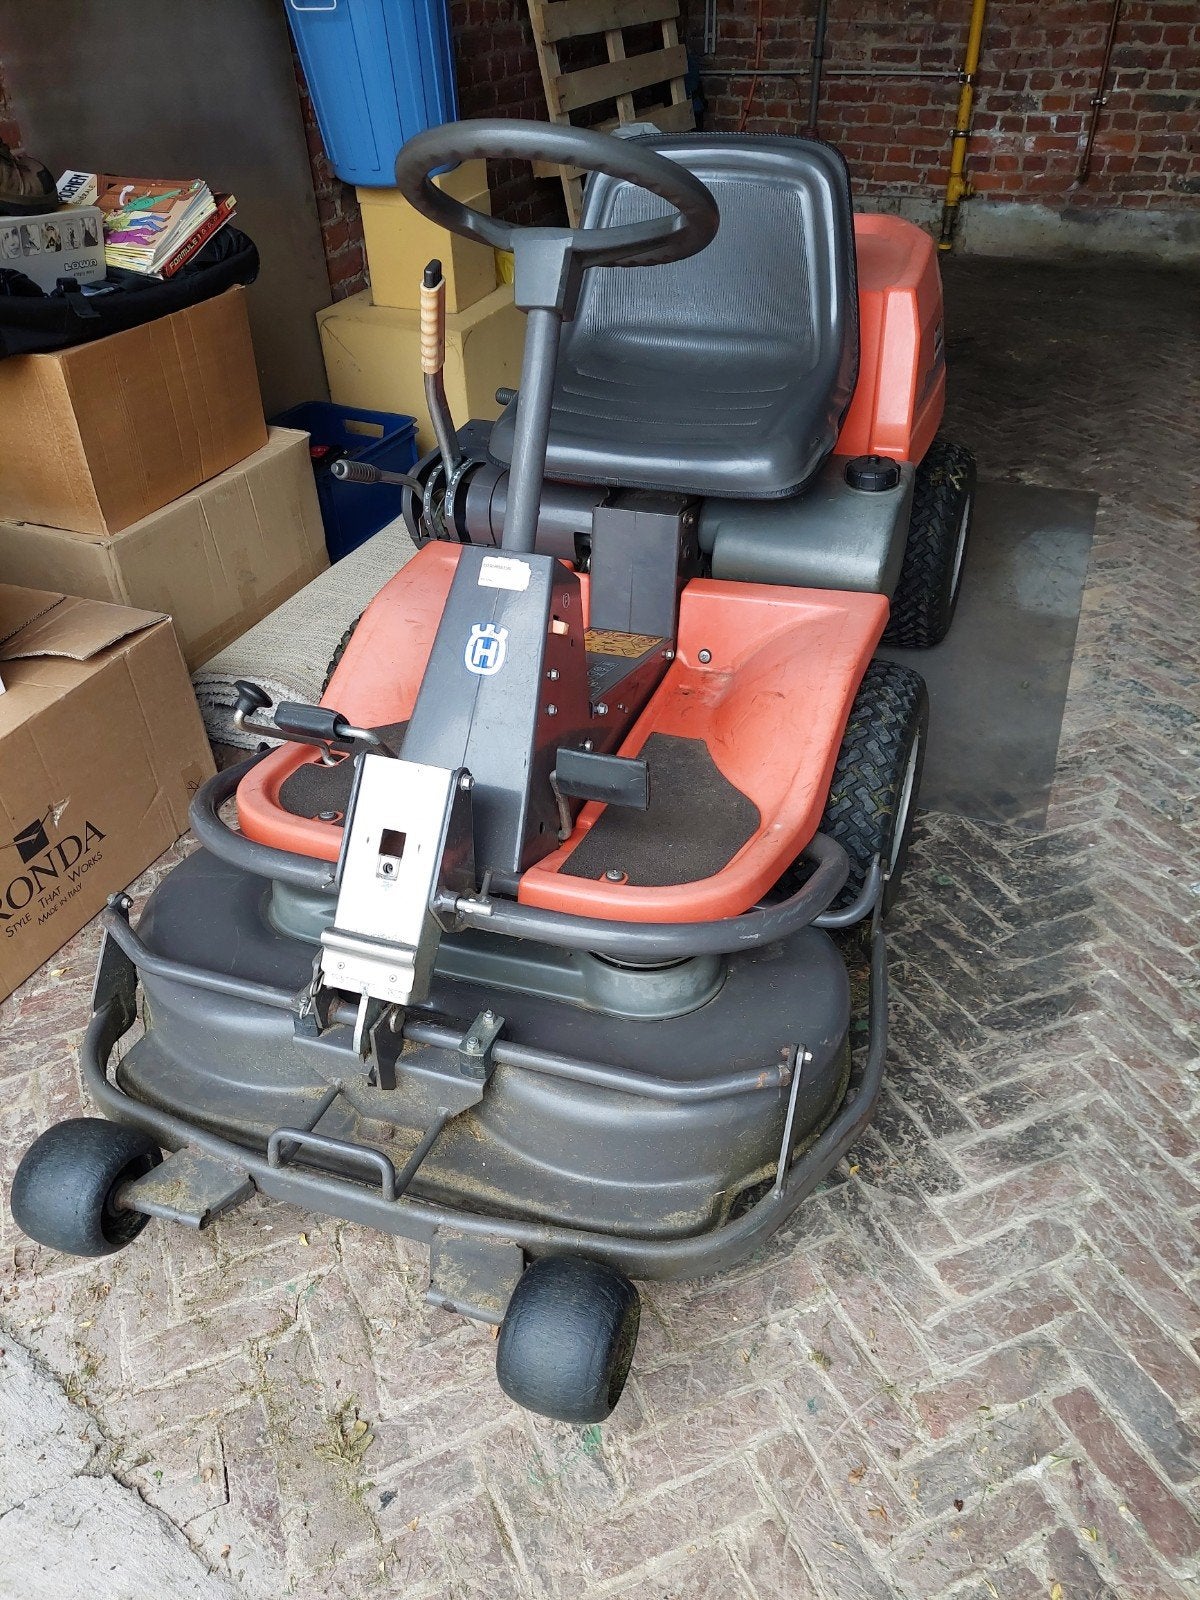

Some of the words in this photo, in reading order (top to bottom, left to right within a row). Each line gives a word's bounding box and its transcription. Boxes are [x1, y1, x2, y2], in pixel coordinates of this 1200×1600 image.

[64, 259, 97, 271] LOWA
[169, 237, 199, 269] FORMULE
[5, 912, 33, 938] STYLE
[37, 885, 61, 909] THAT
[67, 851, 103, 883] WORKS
[37, 904, 59, 926] MADE
[59, 895, 69, 907] IN
[67, 882, 83, 899] ITALY
